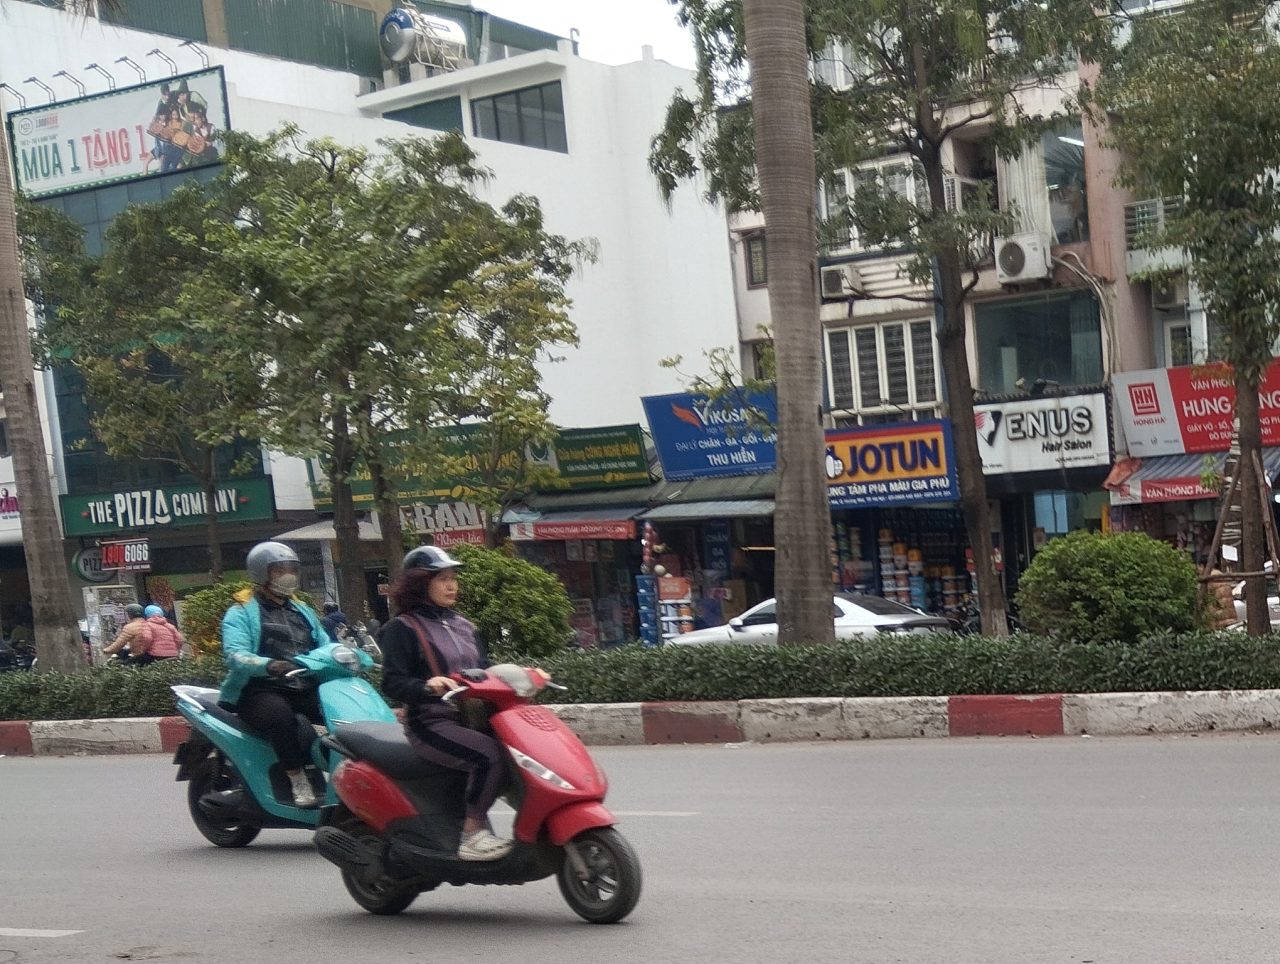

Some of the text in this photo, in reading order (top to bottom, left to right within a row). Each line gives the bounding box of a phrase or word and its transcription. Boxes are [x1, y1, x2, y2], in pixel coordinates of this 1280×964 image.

[21, 124, 149, 181] MUA 1 TẶNG 1
[706, 445, 757, 467] THU HIỀN
[846, 437, 941, 477] JOTUN
[1041, 439, 1093, 453] Hair Salon
[847, 482, 867, 496] TÂM
[868, 482, 888, 494] PHA
[889, 478, 911, 492] MÀU
[911, 479, 928, 491] GIA
[1164, 485, 1194, 497] PHÒNG
[88, 501, 113, 524] THE
[114, 489, 171, 528] PIZZA
